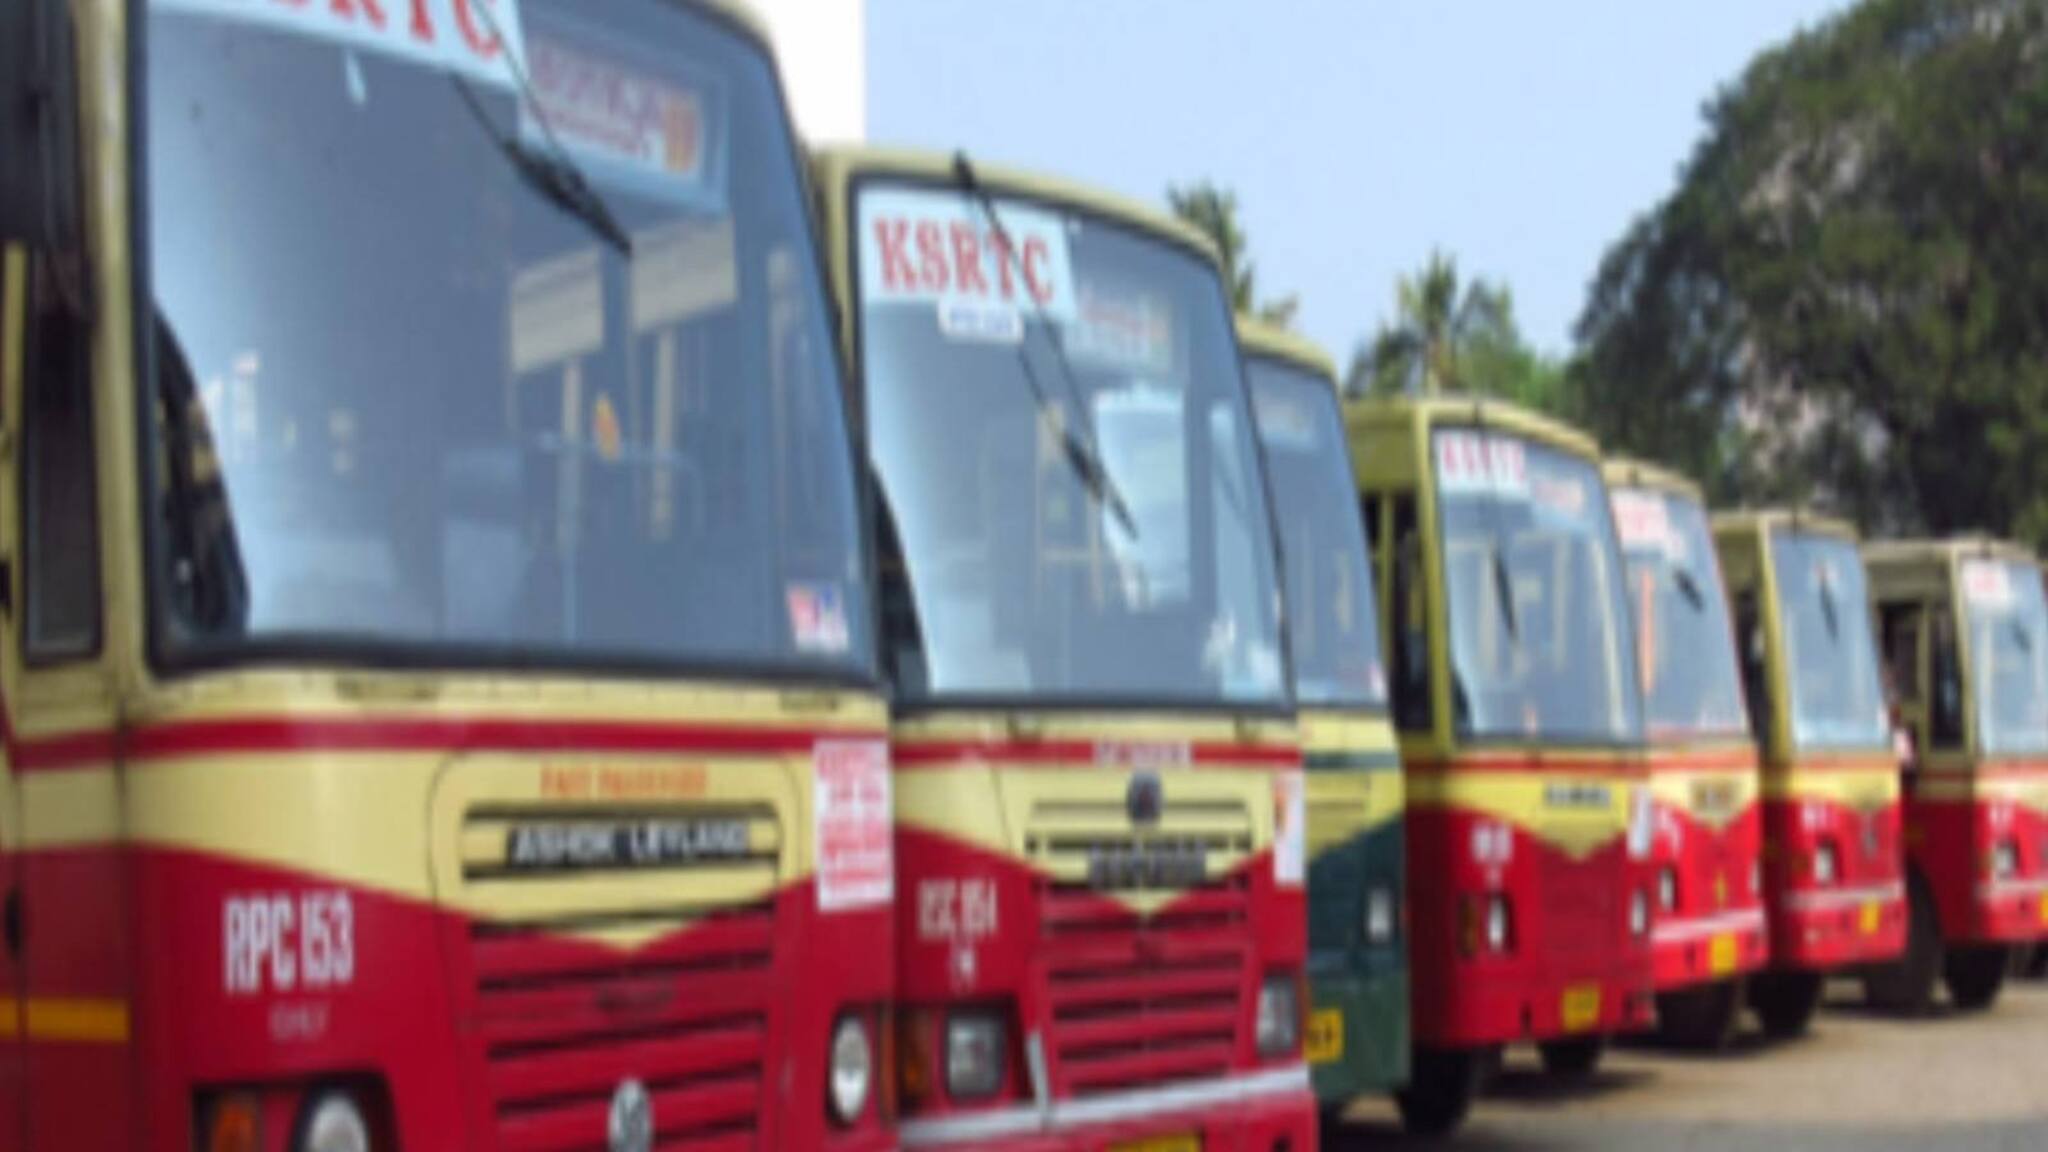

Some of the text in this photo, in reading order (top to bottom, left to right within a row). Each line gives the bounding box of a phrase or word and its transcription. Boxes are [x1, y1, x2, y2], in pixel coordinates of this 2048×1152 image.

[874, 213, 1055, 307] KSRTC
[514, 817, 747, 865] ASHOK LEYLAND
[224, 886, 354, 995] RPC 153
